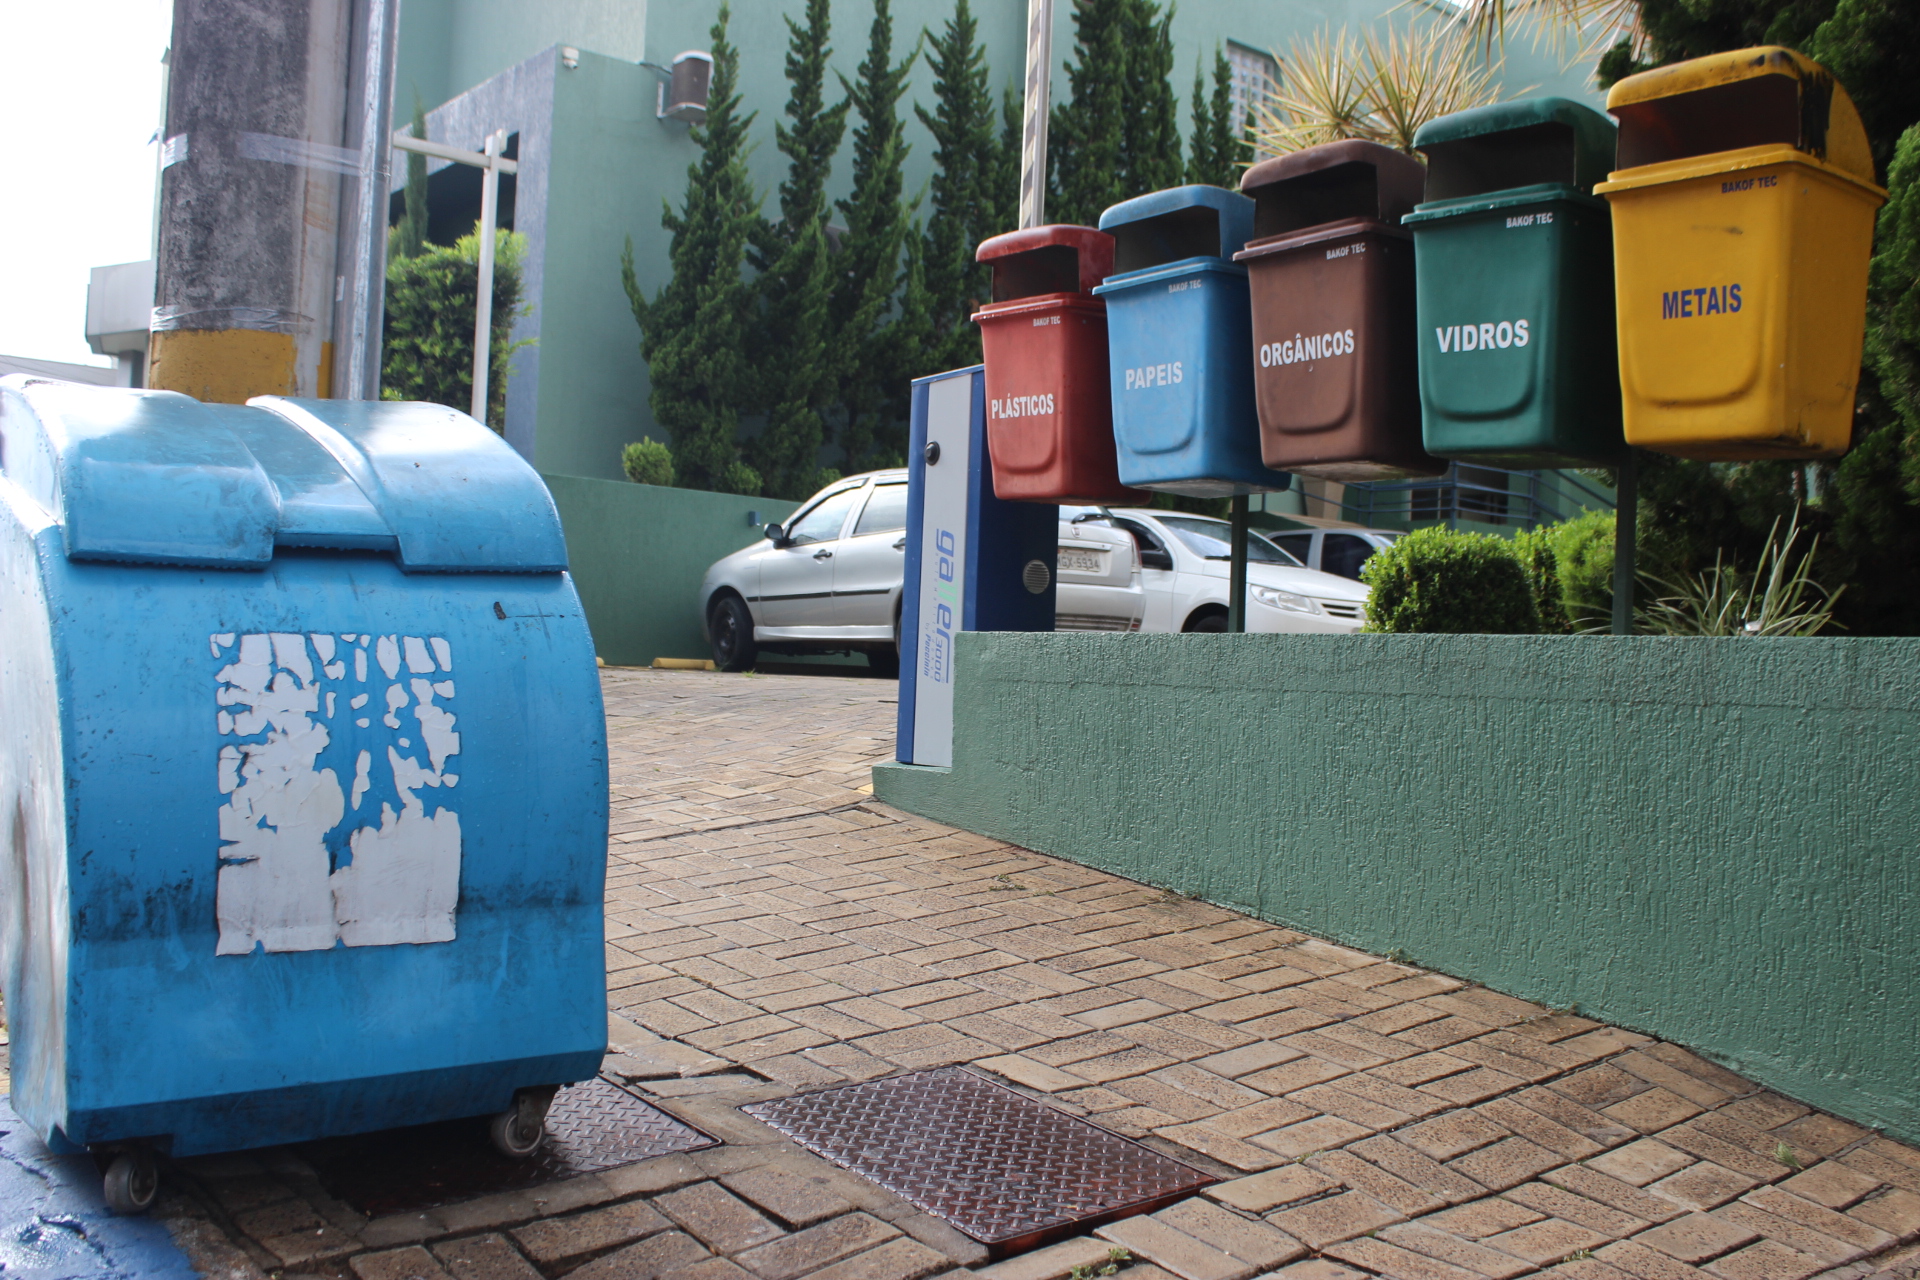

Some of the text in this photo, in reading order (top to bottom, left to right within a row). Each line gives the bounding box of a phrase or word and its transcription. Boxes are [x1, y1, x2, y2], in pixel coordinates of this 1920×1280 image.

[1721, 175, 1777, 194] BAKOF TEC
[1506, 212, 1553, 228] BAKOF TEC
[1326, 242, 1366, 260] BAKOF TEC
[1168, 279, 1202, 293] BAKOF TEC
[1662, 283, 1742, 320] METAIS
[1033, 316, 1061, 327] BAKOF TEC
[1260, 328, 1355, 368] ORGÂNICOS
[1436, 318, 1530, 353] VIDROS
[1125, 361, 1183, 390] PAPEIS
[991, 393, 1054, 419] PLÁSTICOS
[923, 634, 932, 677] Peccinin
[934, 637, 943, 683] 3000
